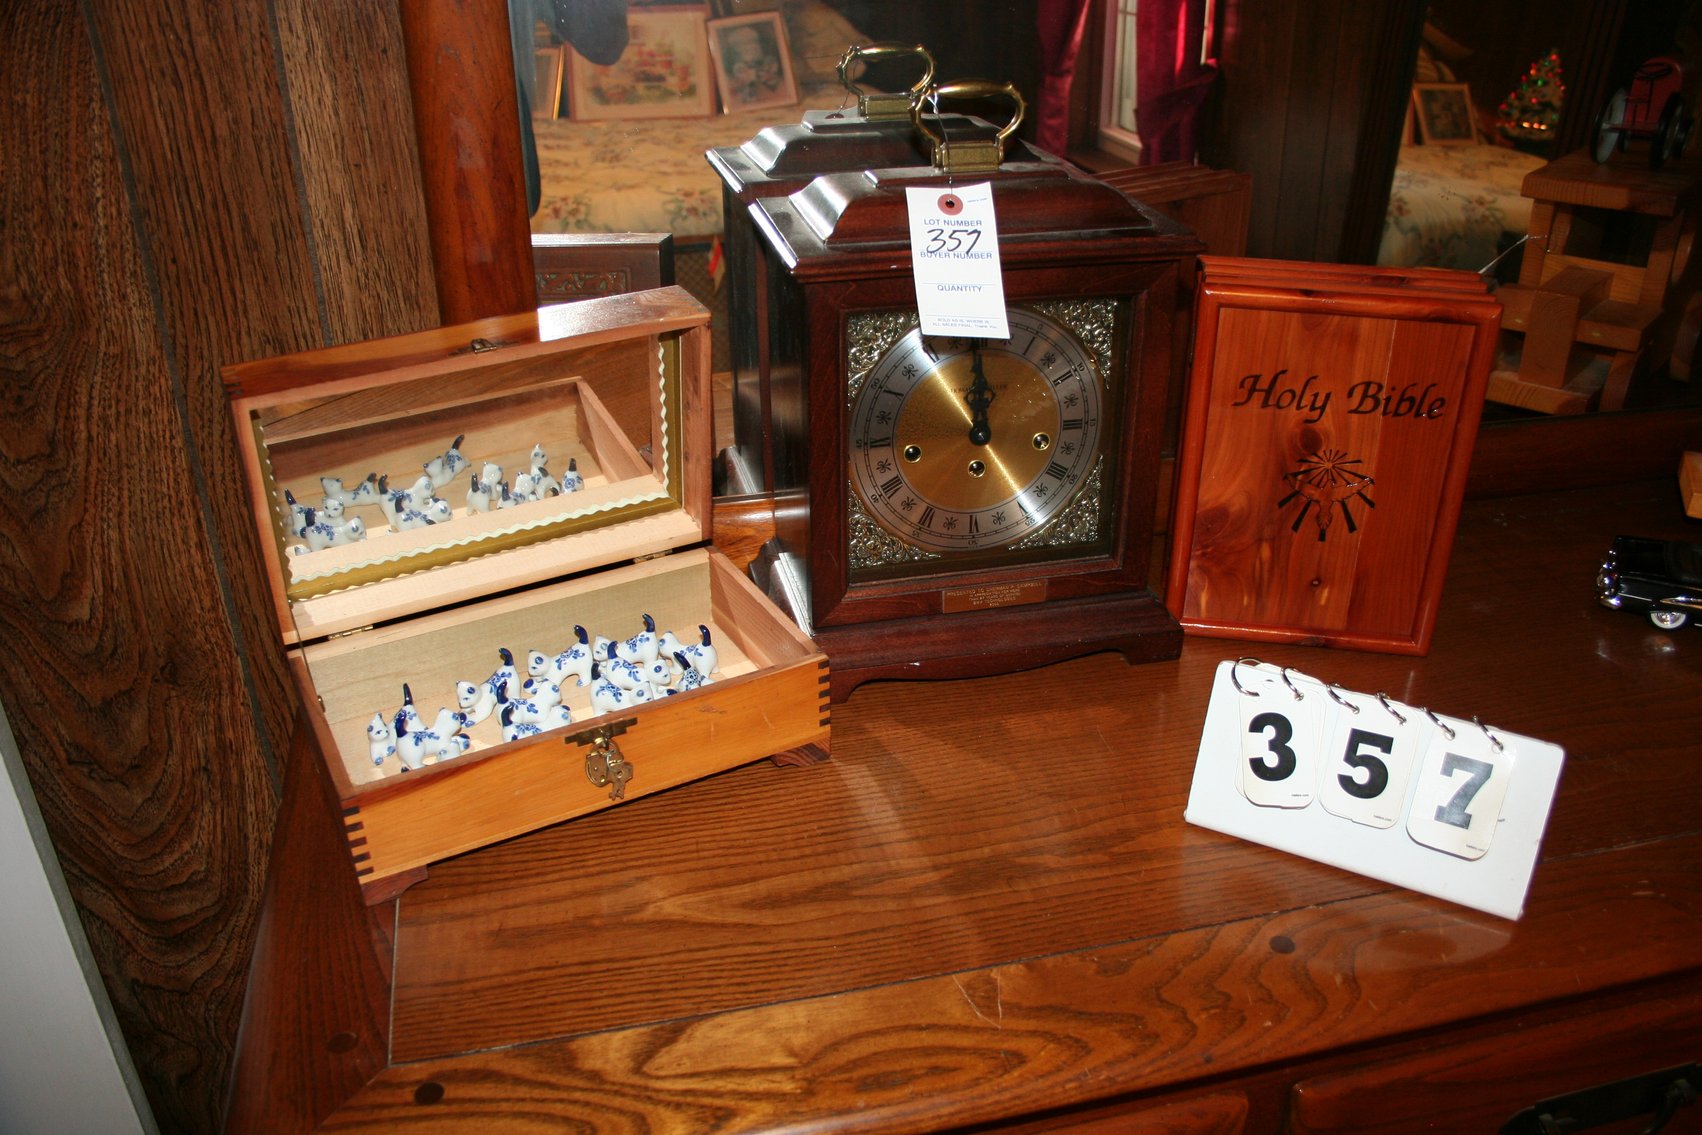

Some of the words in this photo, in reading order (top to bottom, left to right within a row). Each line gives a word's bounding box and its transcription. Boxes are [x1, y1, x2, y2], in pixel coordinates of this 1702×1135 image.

[926, 229, 981, 254] 357
[920, 251, 950, 259] BUYER
[953, 252, 992, 260] NUMBER
[937, 284, 982, 292] QUANTITY
[1077, 361, 1085, 372] 10
[1231, 369, 1332, 424] Holy
[1347, 380, 1446, 420] Bible
[1089, 417, 1096, 428] 15
[1248, 712, 1297, 782] 3
[1337, 727, 1394, 799] 5
[1433, 751, 1494, 830] 7
